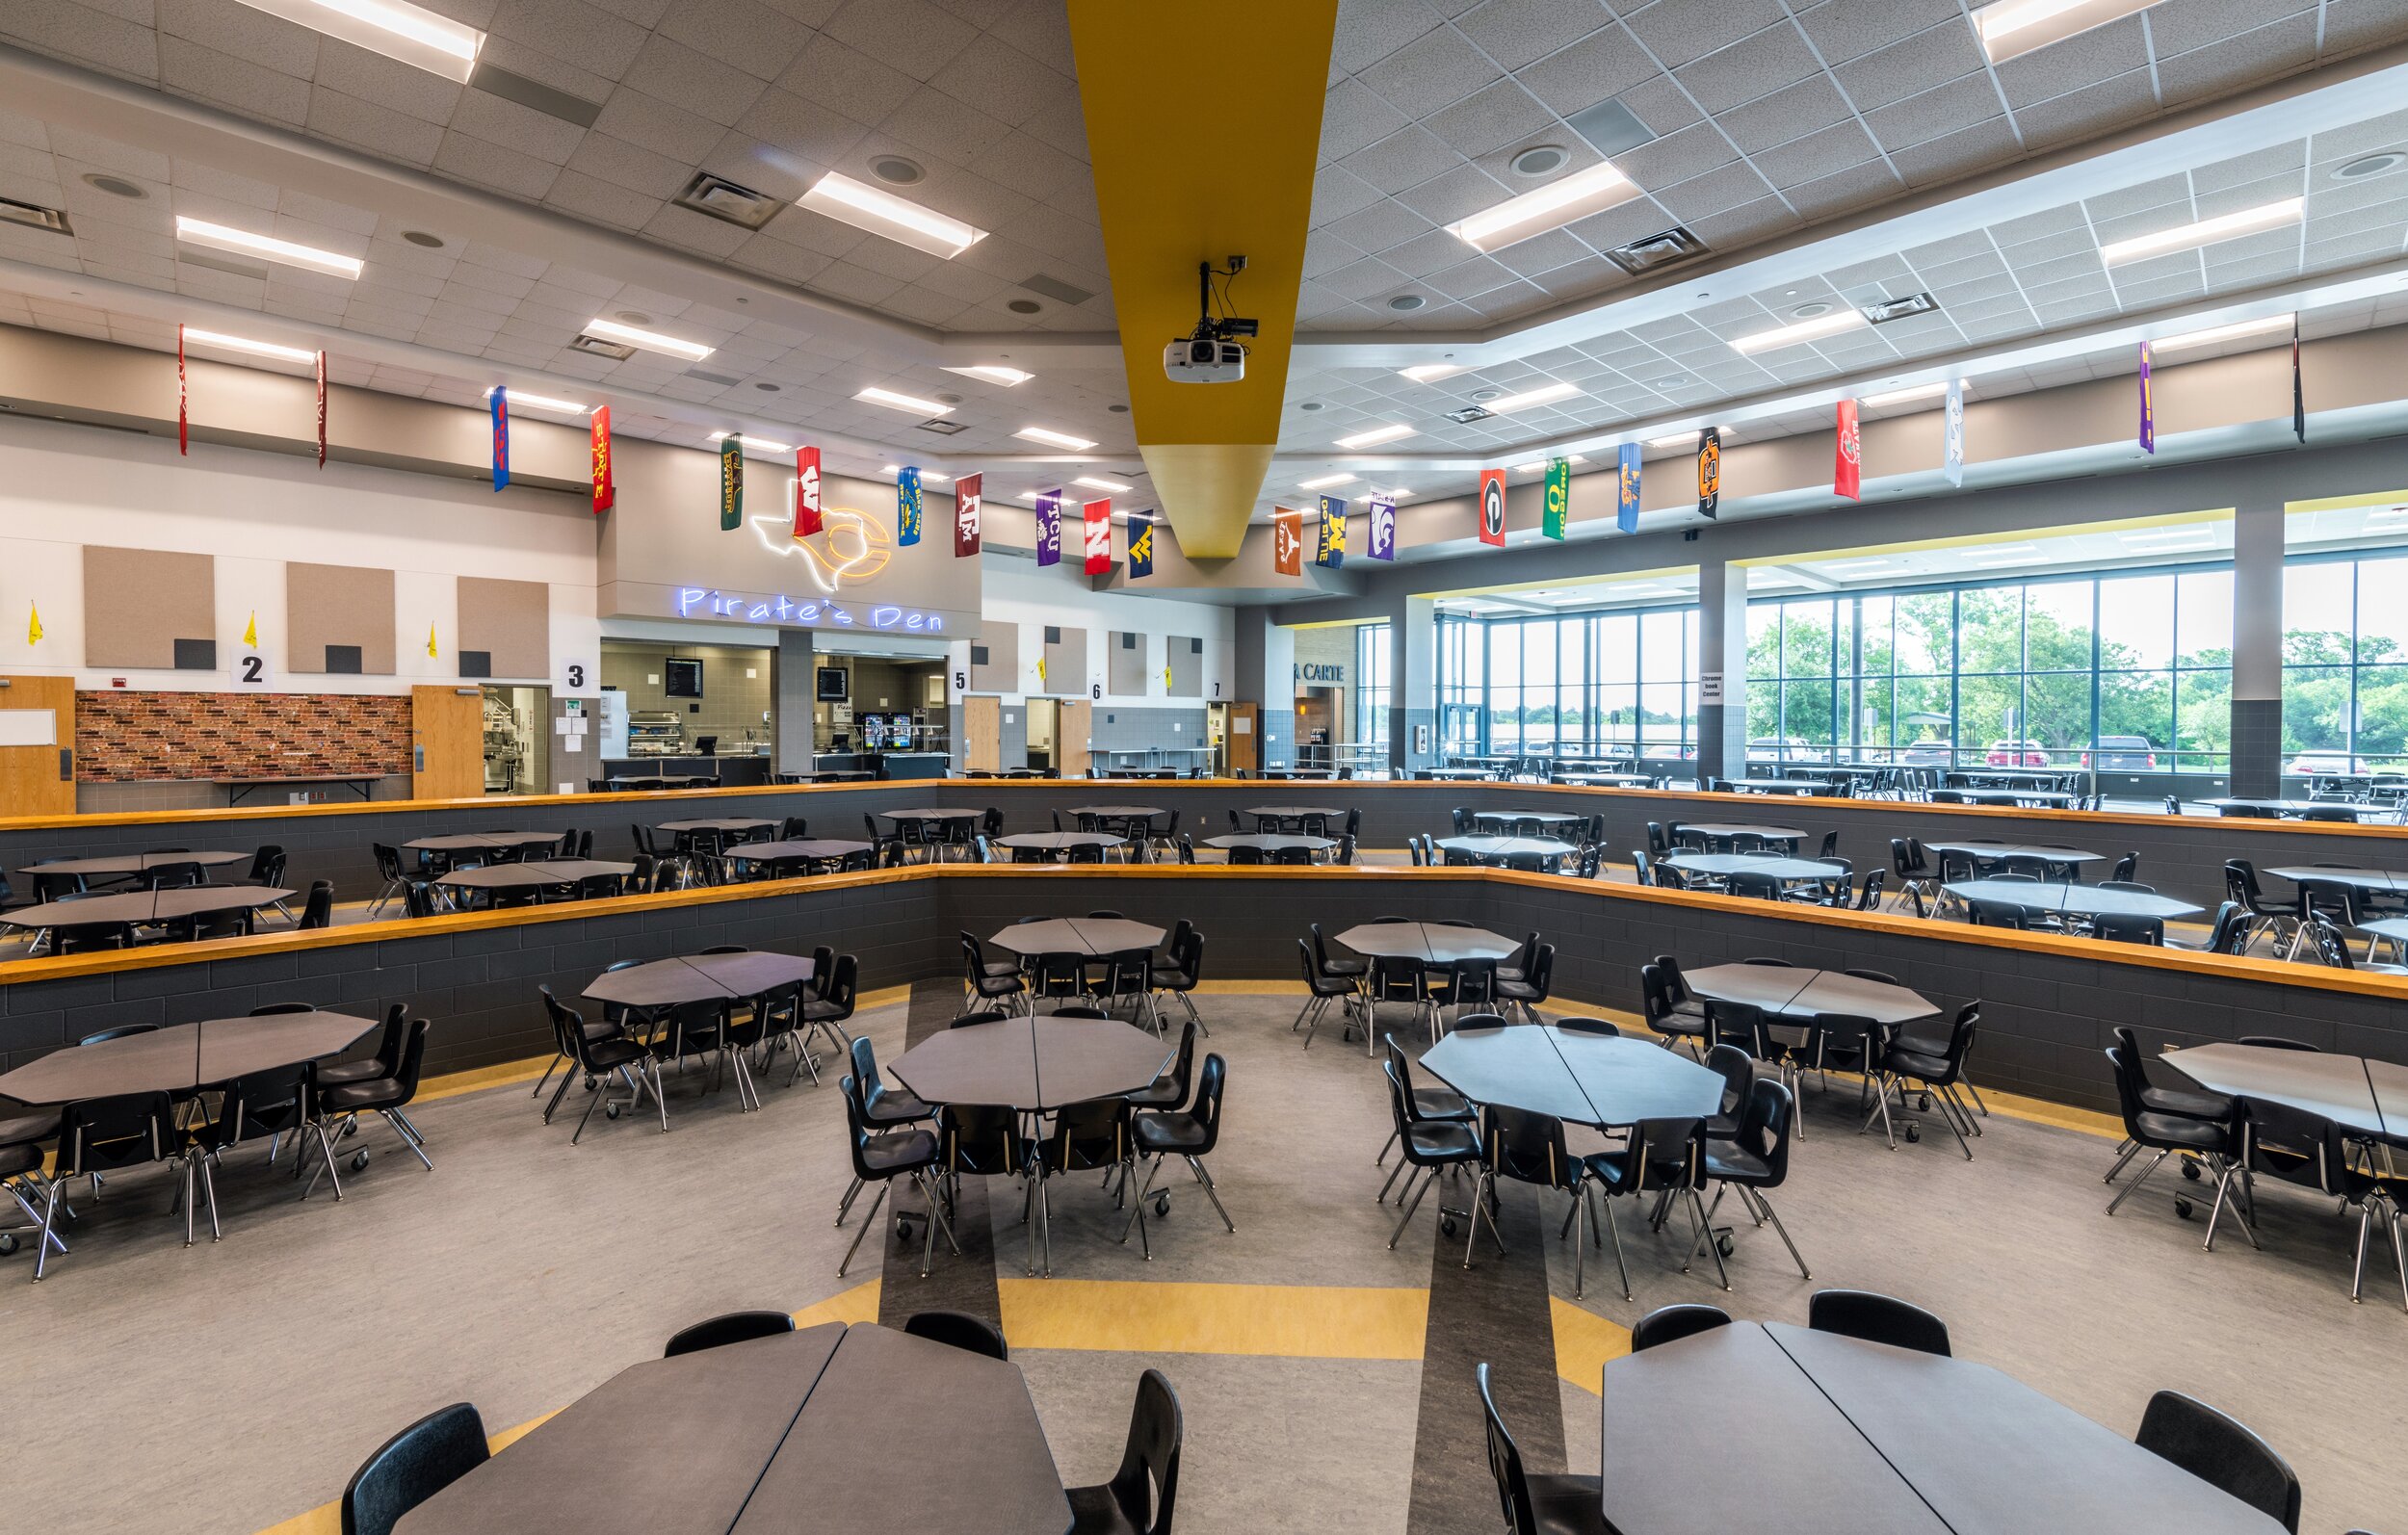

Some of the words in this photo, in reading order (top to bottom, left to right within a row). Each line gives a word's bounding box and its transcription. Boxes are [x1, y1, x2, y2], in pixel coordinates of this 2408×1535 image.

[799, 465, 820, 512] W
[1048, 504, 1060, 552] TCU
[682, 586, 853, 625] Pirate's
[874, 607, 942, 631] Den
[242, 656, 263, 683] 2
[568, 664, 585, 689] 3
[955, 672, 965, 689] 5
[1303, 663, 1345, 682] CARTE
[1092, 684, 1101, 700] 6
[1215, 682, 1220, 697] 7
